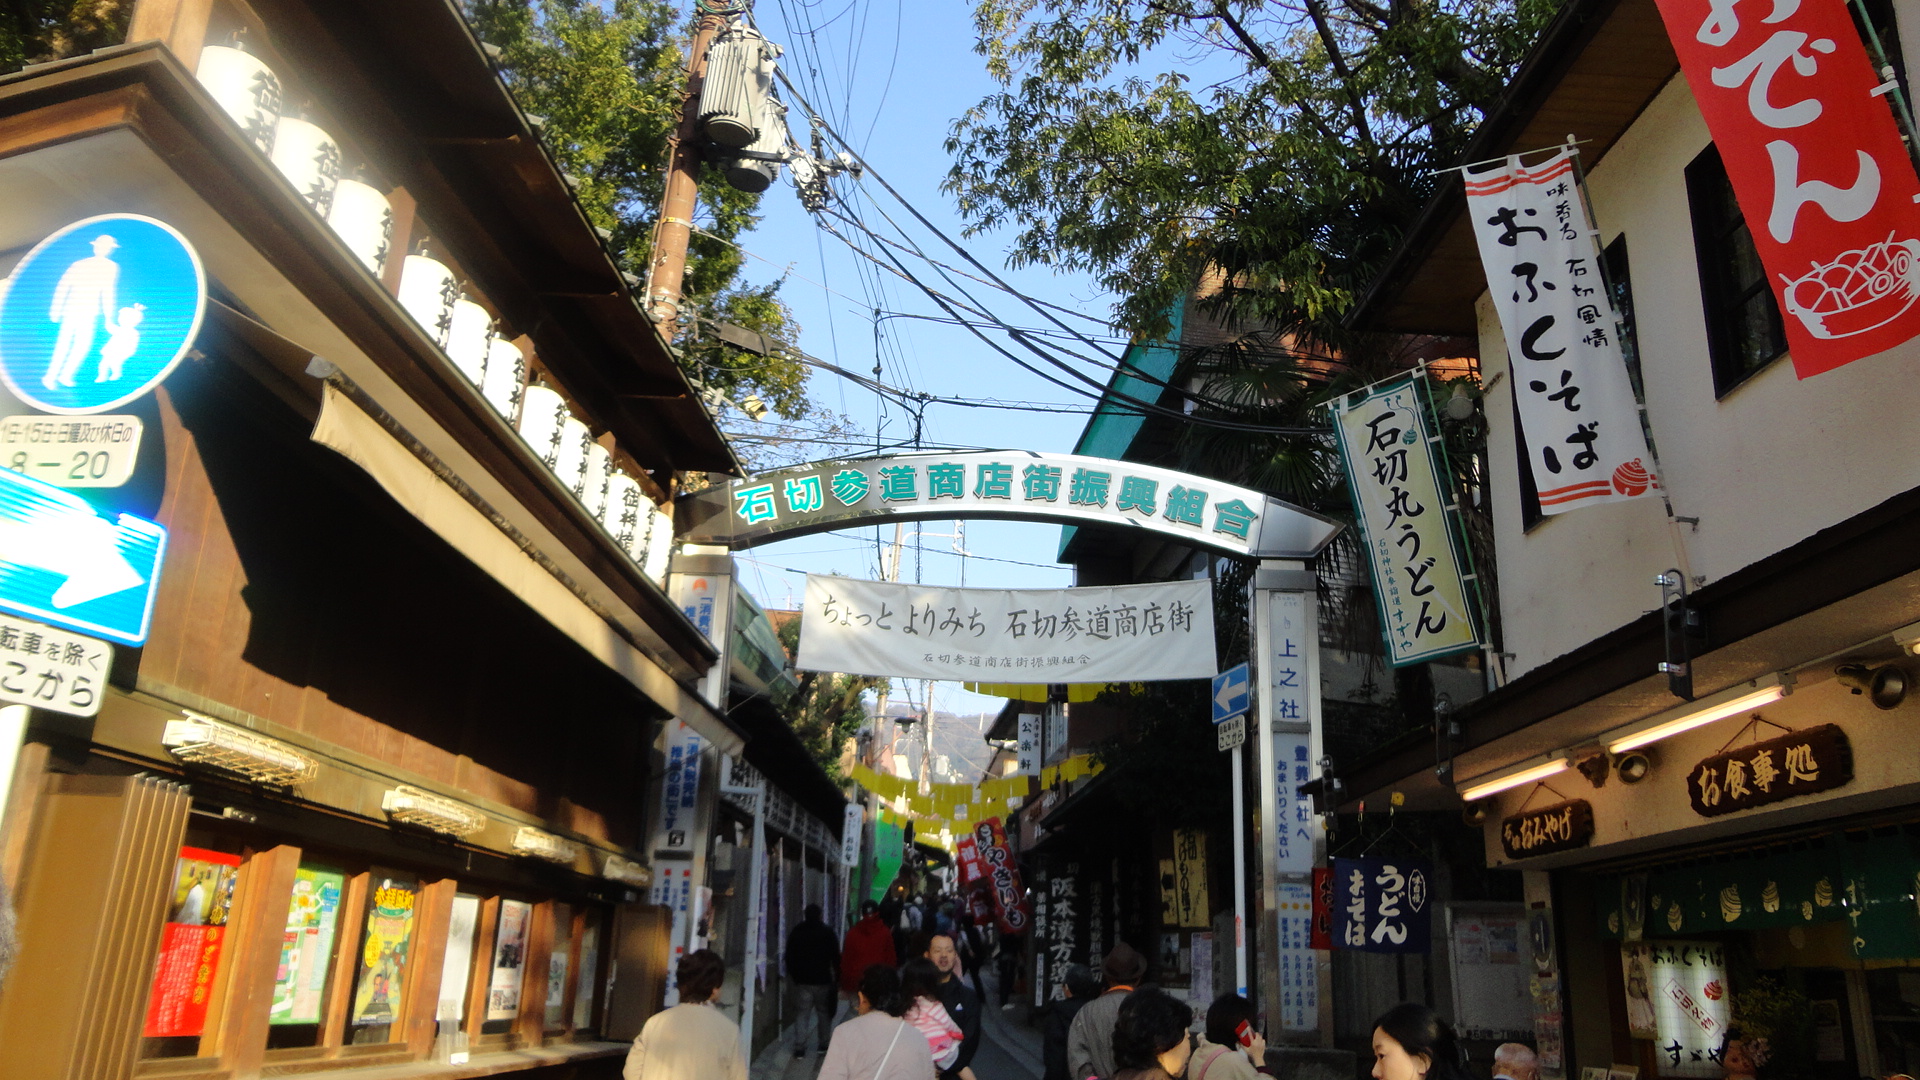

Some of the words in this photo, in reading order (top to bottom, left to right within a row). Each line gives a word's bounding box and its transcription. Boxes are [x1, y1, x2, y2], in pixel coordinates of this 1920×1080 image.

[1487, 206, 1600, 475] おふくそば
[1565, 257, 1609, 348] 石切風情
[734, 462, 1258, 540] 石切参道商店街振興組合
[1365, 411, 1447, 639] 石切丸うどん
[821, 593, 893, 631] ちょっと
[901, 605, 986, 639] よりみち
[1004, 601, 1195, 641] 石切参道商店街
[922, 652, 1091, 669] 石切参道商店街振興組合
[1278, 638, 1301, 719] 上之社
[1219, 729, 1244, 749] ここから
[1698, 743, 1820, 808] お食事処
[1277, 759, 1290, 860] おまいりください
[985, 846, 1026, 929] やきいも
[1370, 864, 1408, 945] うどん
[1650, 943, 1725, 967] おふくそば
